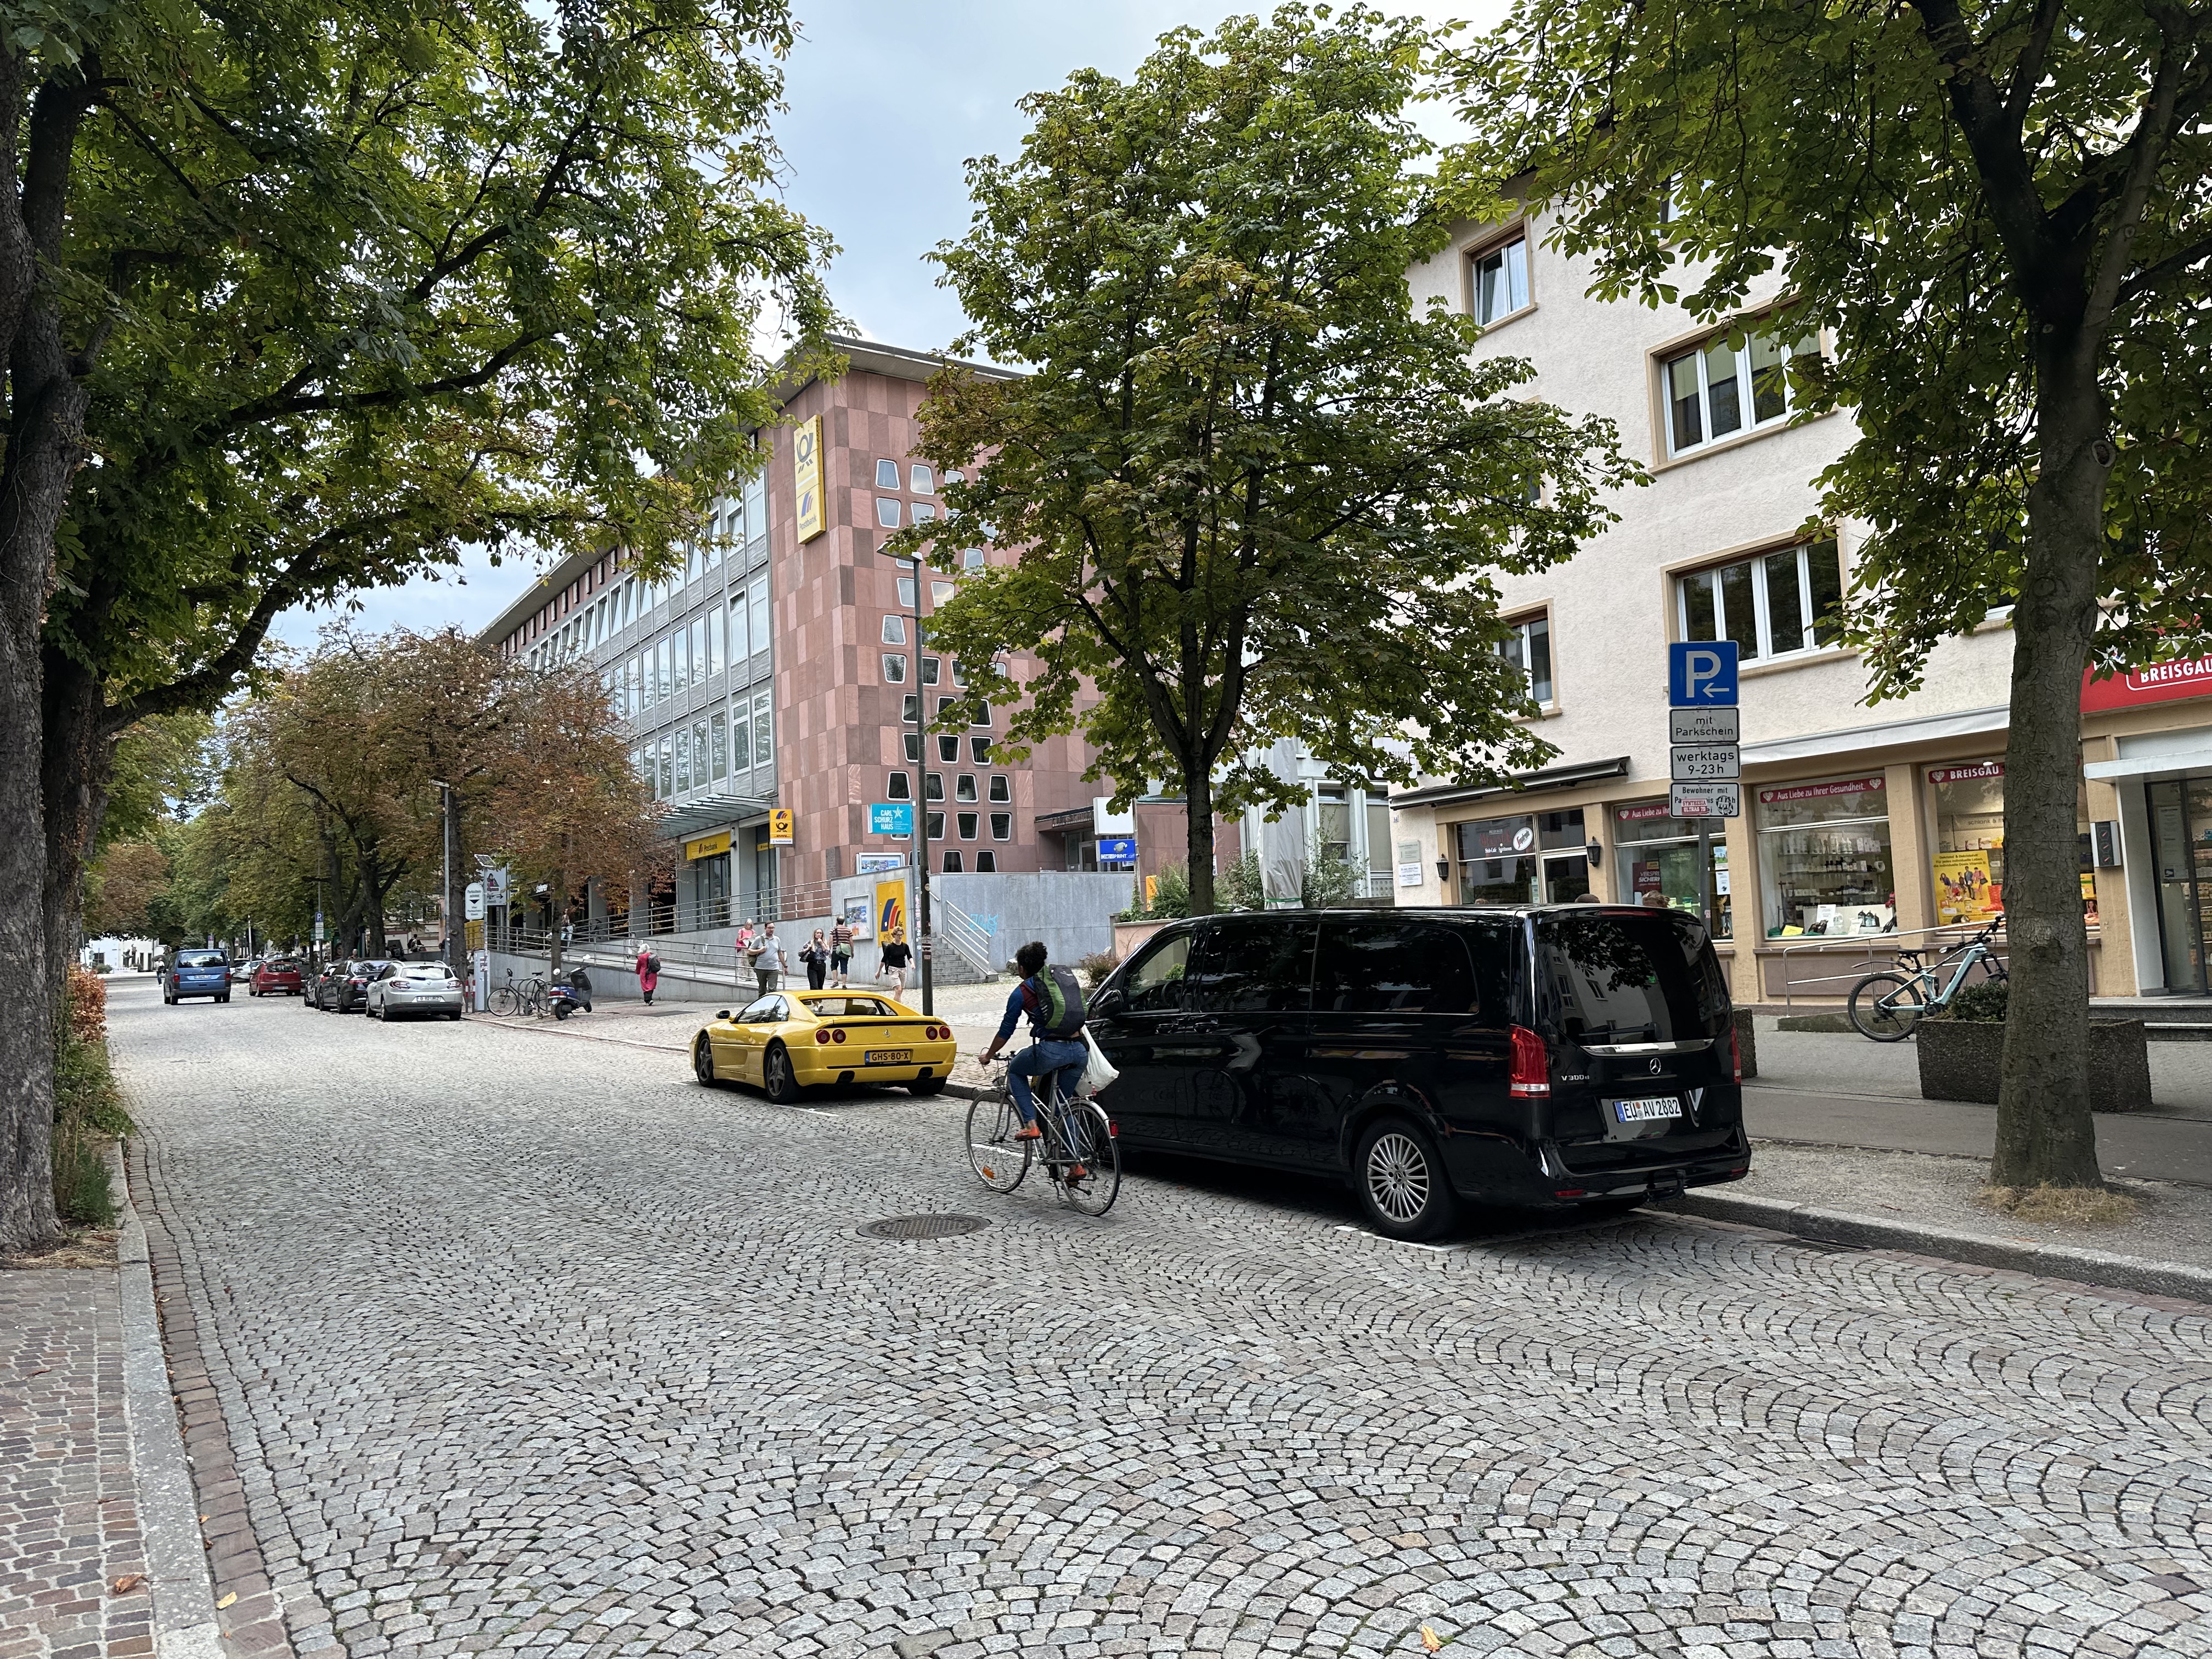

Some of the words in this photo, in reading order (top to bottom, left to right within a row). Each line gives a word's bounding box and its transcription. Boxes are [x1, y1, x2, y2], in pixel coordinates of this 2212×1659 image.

[799, 513, 817, 531] Postbank
[1686, 650, 1722, 698] P
[2140, 658, 2212, 684] BREISGAU
[1696, 716, 1712, 725] mit
[1676, 726, 1733, 736] Parkschein
[1677, 751, 1734, 763] werktags
[1950, 765, 1999, 780] BREISGAU
[1777, 792, 1788, 800] Aus
[1789, 791, 1804, 799] Liebe
[1813, 787, 1828, 795] Ihrer
[1830, 783, 1866, 793] Gesundheit.
[1642, 808, 1655, 817] Liebe
[704, 842, 718, 852] Postbank
[872, 1052, 909, 1061] GHS-80-X
[1656, 1099, 1680, 1116] 2882
